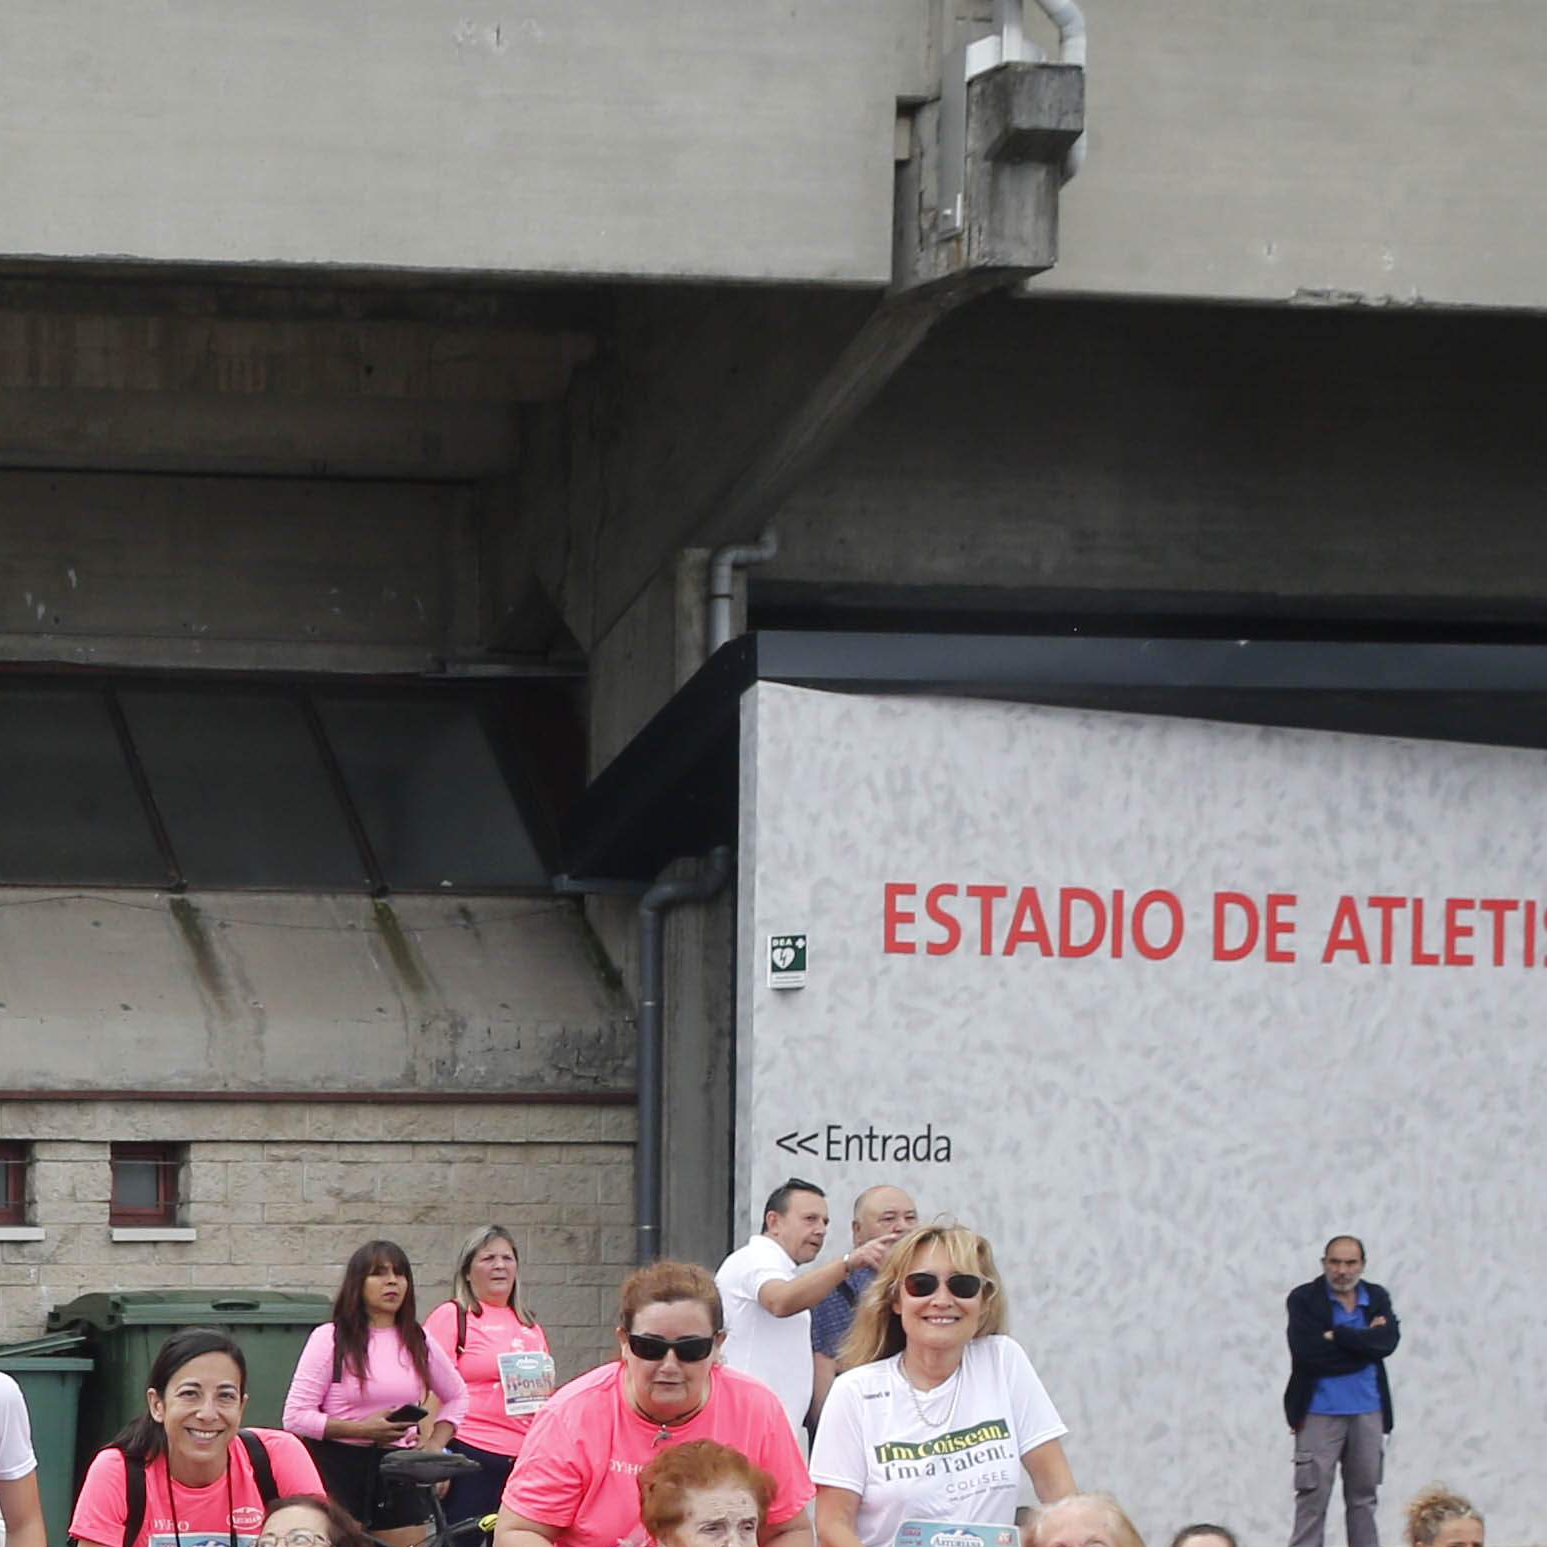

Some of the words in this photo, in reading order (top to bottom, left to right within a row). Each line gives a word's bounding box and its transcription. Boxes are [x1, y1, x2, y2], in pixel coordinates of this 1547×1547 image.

[882, 882, 1185, 961] ESTADIO
[1212, 892, 1298, 964] DE
[1321, 895, 1547, 969] ATLETI
[772, 938, 793, 947] DEA
[825, 1123, 952, 1164] Entrada
[879, 1442, 915, 1464] I'm
[884, 1462, 919, 1482] I'm
[925, 1462, 936, 1477] a
[945, 1470, 1010, 1494] COLISEE
